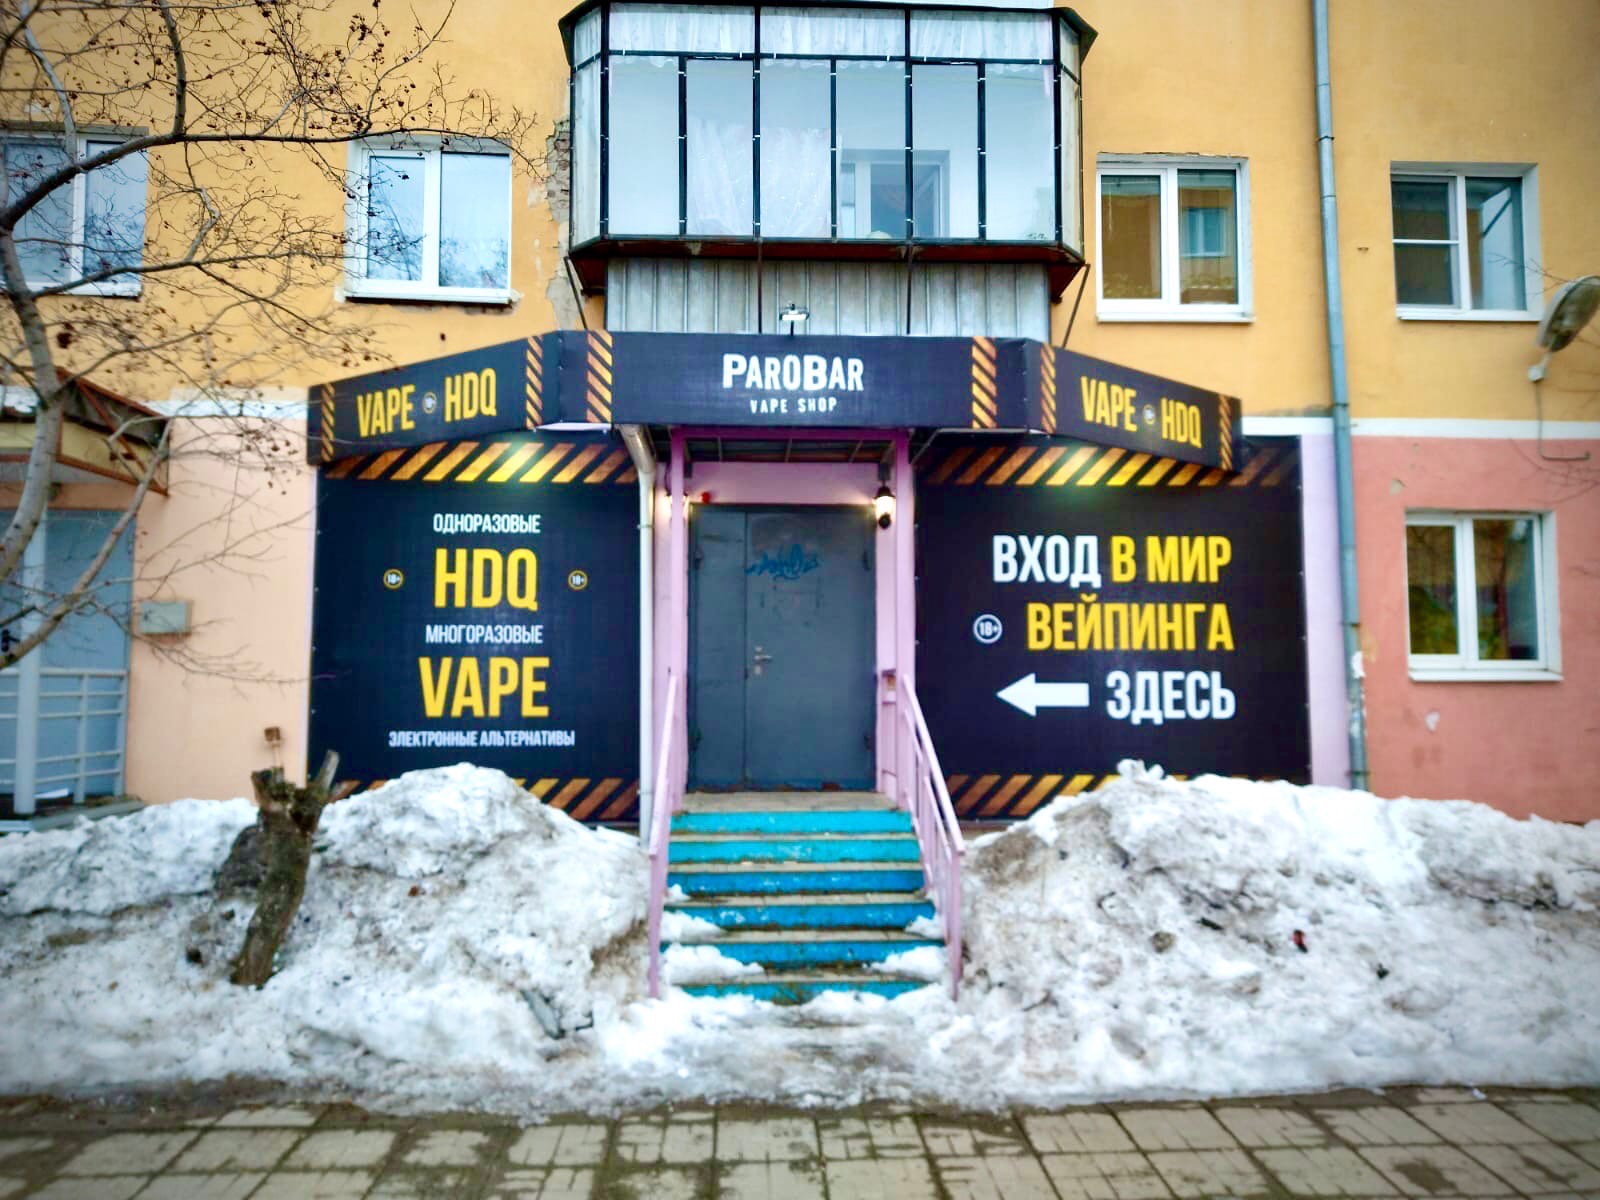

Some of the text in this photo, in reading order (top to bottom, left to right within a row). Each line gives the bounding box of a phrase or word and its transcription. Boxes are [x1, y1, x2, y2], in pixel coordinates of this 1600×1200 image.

[357, 367, 497, 437] VAPE HDQ
[750, 397, 838, 414] VAPE SHOP
[1081, 375, 1202, 449] VAPE HDQ
[433, 513, 541, 535] ОДНОРАЗОВЫЕ
[433, 547, 539, 612] HDQ
[992, 535, 1232, 588] ВХОД В МИР
[425, 624, 543, 645] МНОГОРАЗОВЫЕ
[1026, 593, 1234, 651] ВЕЙПИНГА
[418, 656, 550, 718] VAPE
[1105, 670, 1236, 725] ЗДЕСЬ
[388, 730, 575, 748] ЭЛЕКТРОННЫЕ АЛЬТЕРНАТИВЫ
